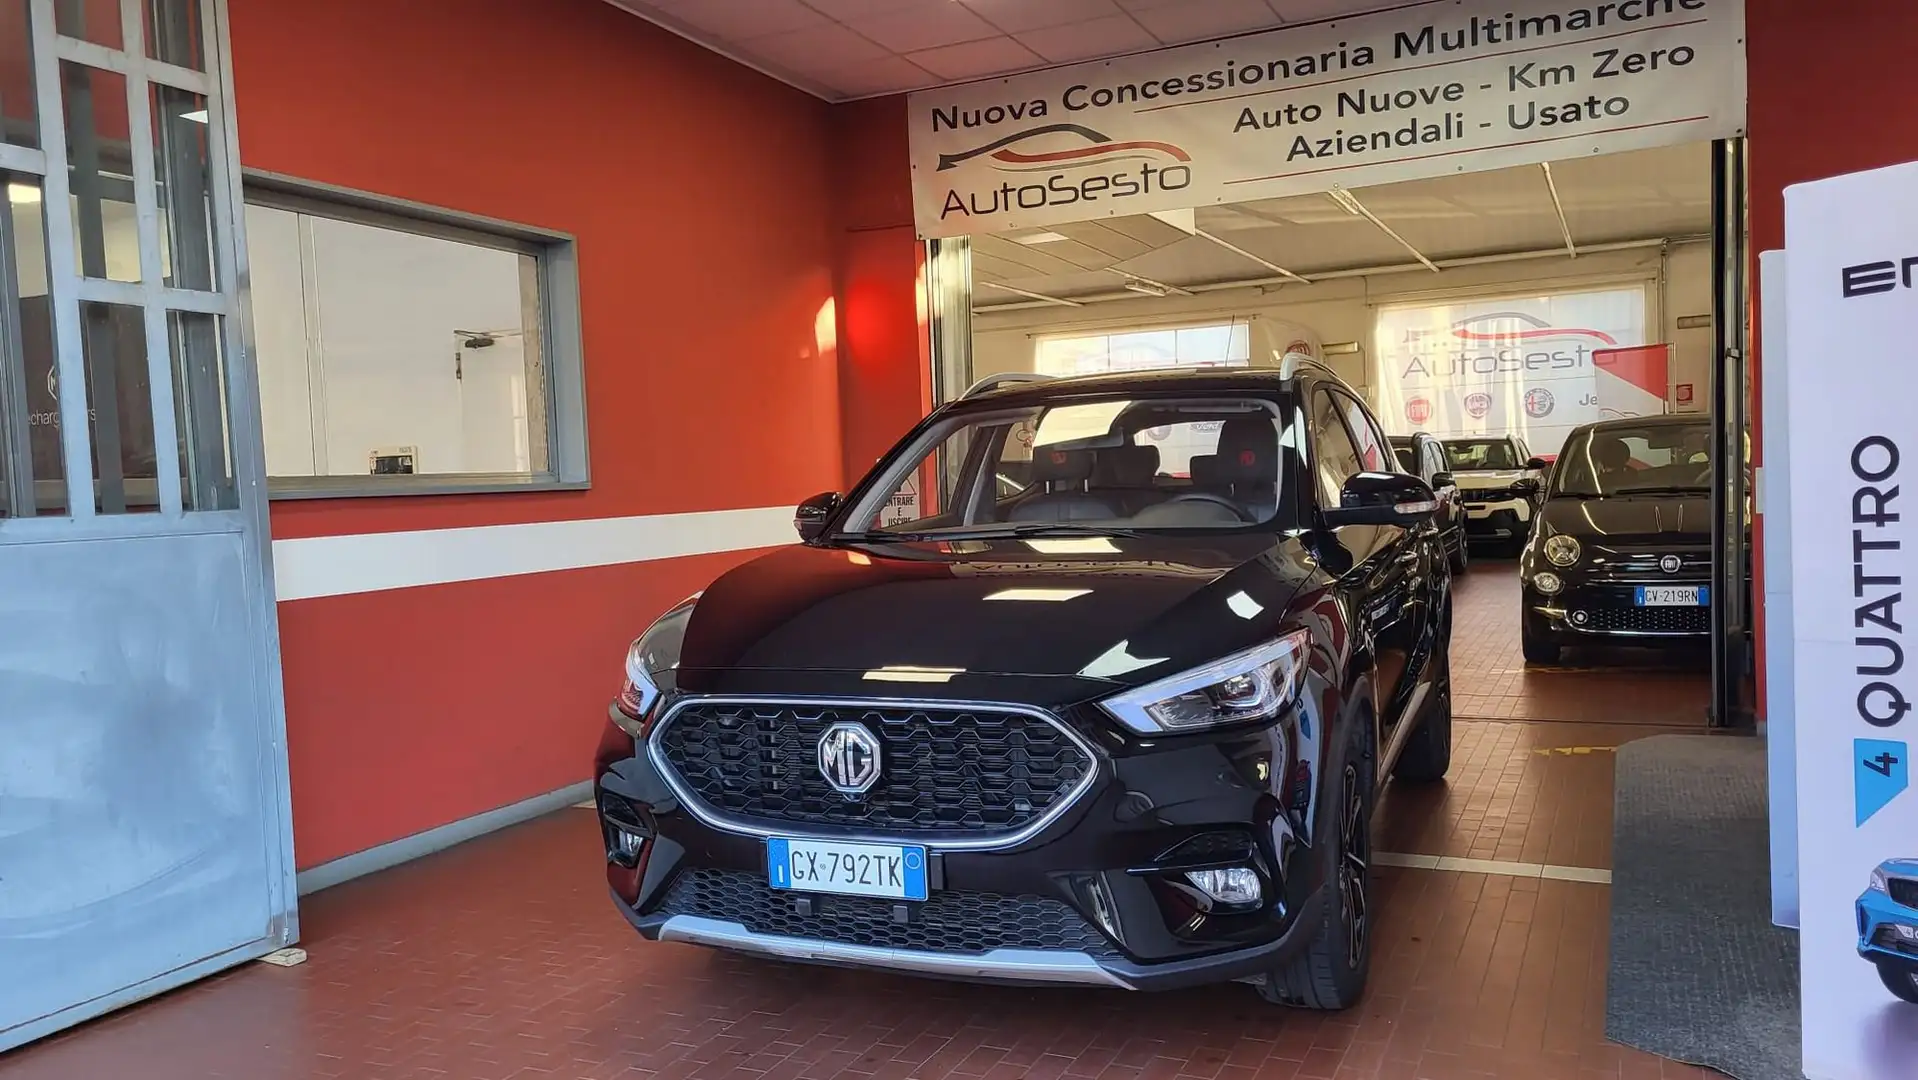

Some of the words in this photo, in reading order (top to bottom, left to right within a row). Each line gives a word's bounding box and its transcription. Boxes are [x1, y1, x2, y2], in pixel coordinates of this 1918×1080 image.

[932, 98, 1048, 132] Nuova
[1062, 42, 1375, 111] Concessionaria
[1233, 103, 1322, 133] Auto
[1337, 77, 1465, 118] Nuove
[1508, 62, 1576, 92] Km
[1592, 45, 1695, 79] Zero
[1286, 111, 1464, 162] Aziendali
[1507, 95, 1630, 130] Usato
[940, 162, 1191, 220] AutoSesto
[1850, 435, 1912, 728] QUATTRO
[823, 730, 872, 786] MG
[1863, 752, 1899, 778] 4
